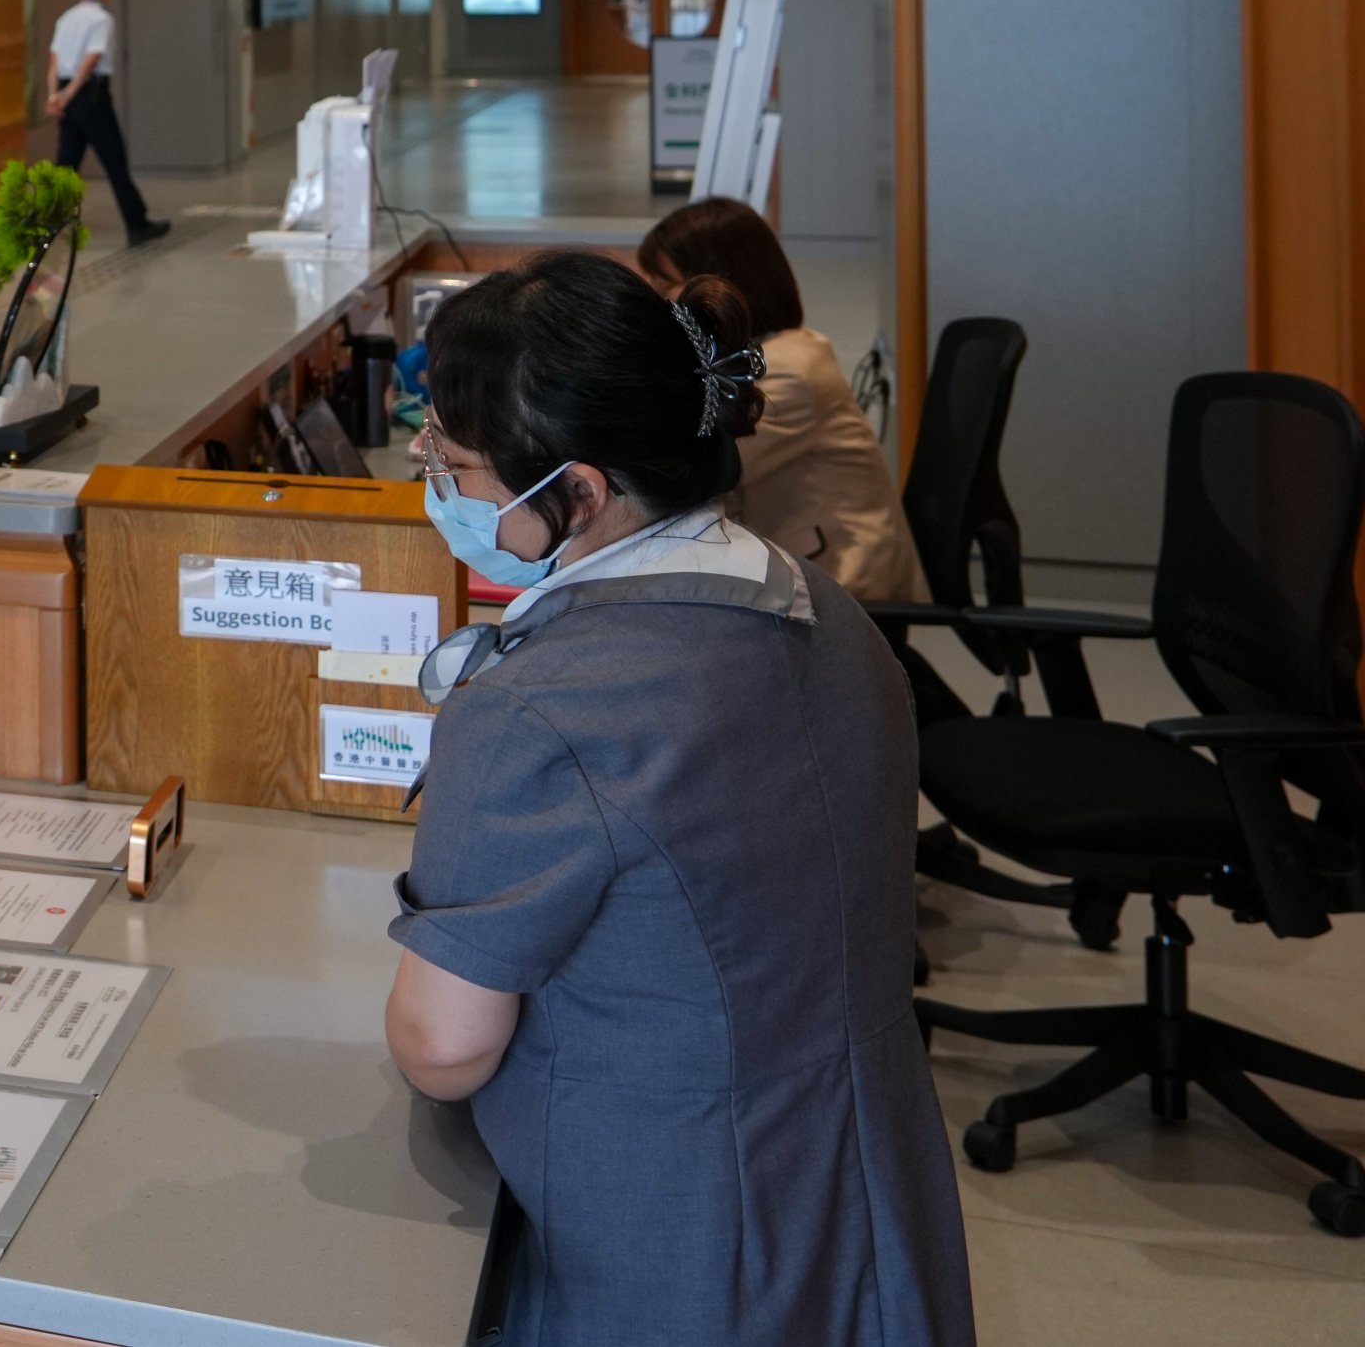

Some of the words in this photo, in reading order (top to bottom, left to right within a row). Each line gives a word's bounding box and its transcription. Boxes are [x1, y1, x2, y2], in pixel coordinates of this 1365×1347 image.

[223, 567, 315, 602] 意見箱
[192, 606, 303, 629] Suggestion
[310, 615, 332, 631] Bo
